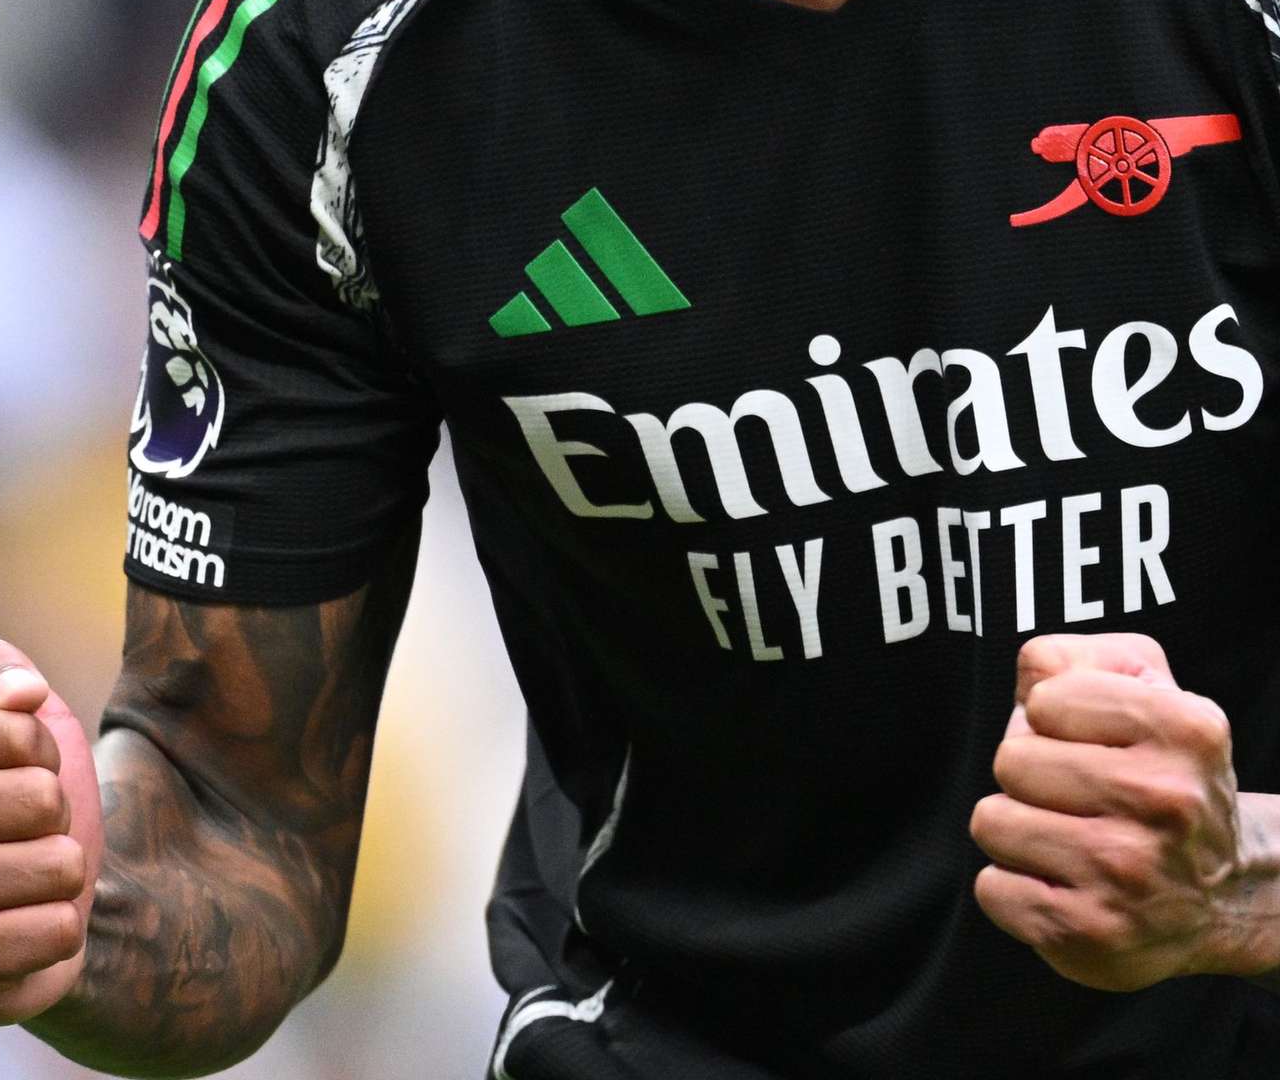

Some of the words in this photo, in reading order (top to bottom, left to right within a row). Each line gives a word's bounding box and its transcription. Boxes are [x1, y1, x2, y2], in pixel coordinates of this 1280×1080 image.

[502, 302, 1265, 523] Emirates
[132, 526, 225, 588] racism
[139, 490, 212, 547] room
[687, 537, 825, 661] FLY
[871, 483, 1177, 644] BETTER
